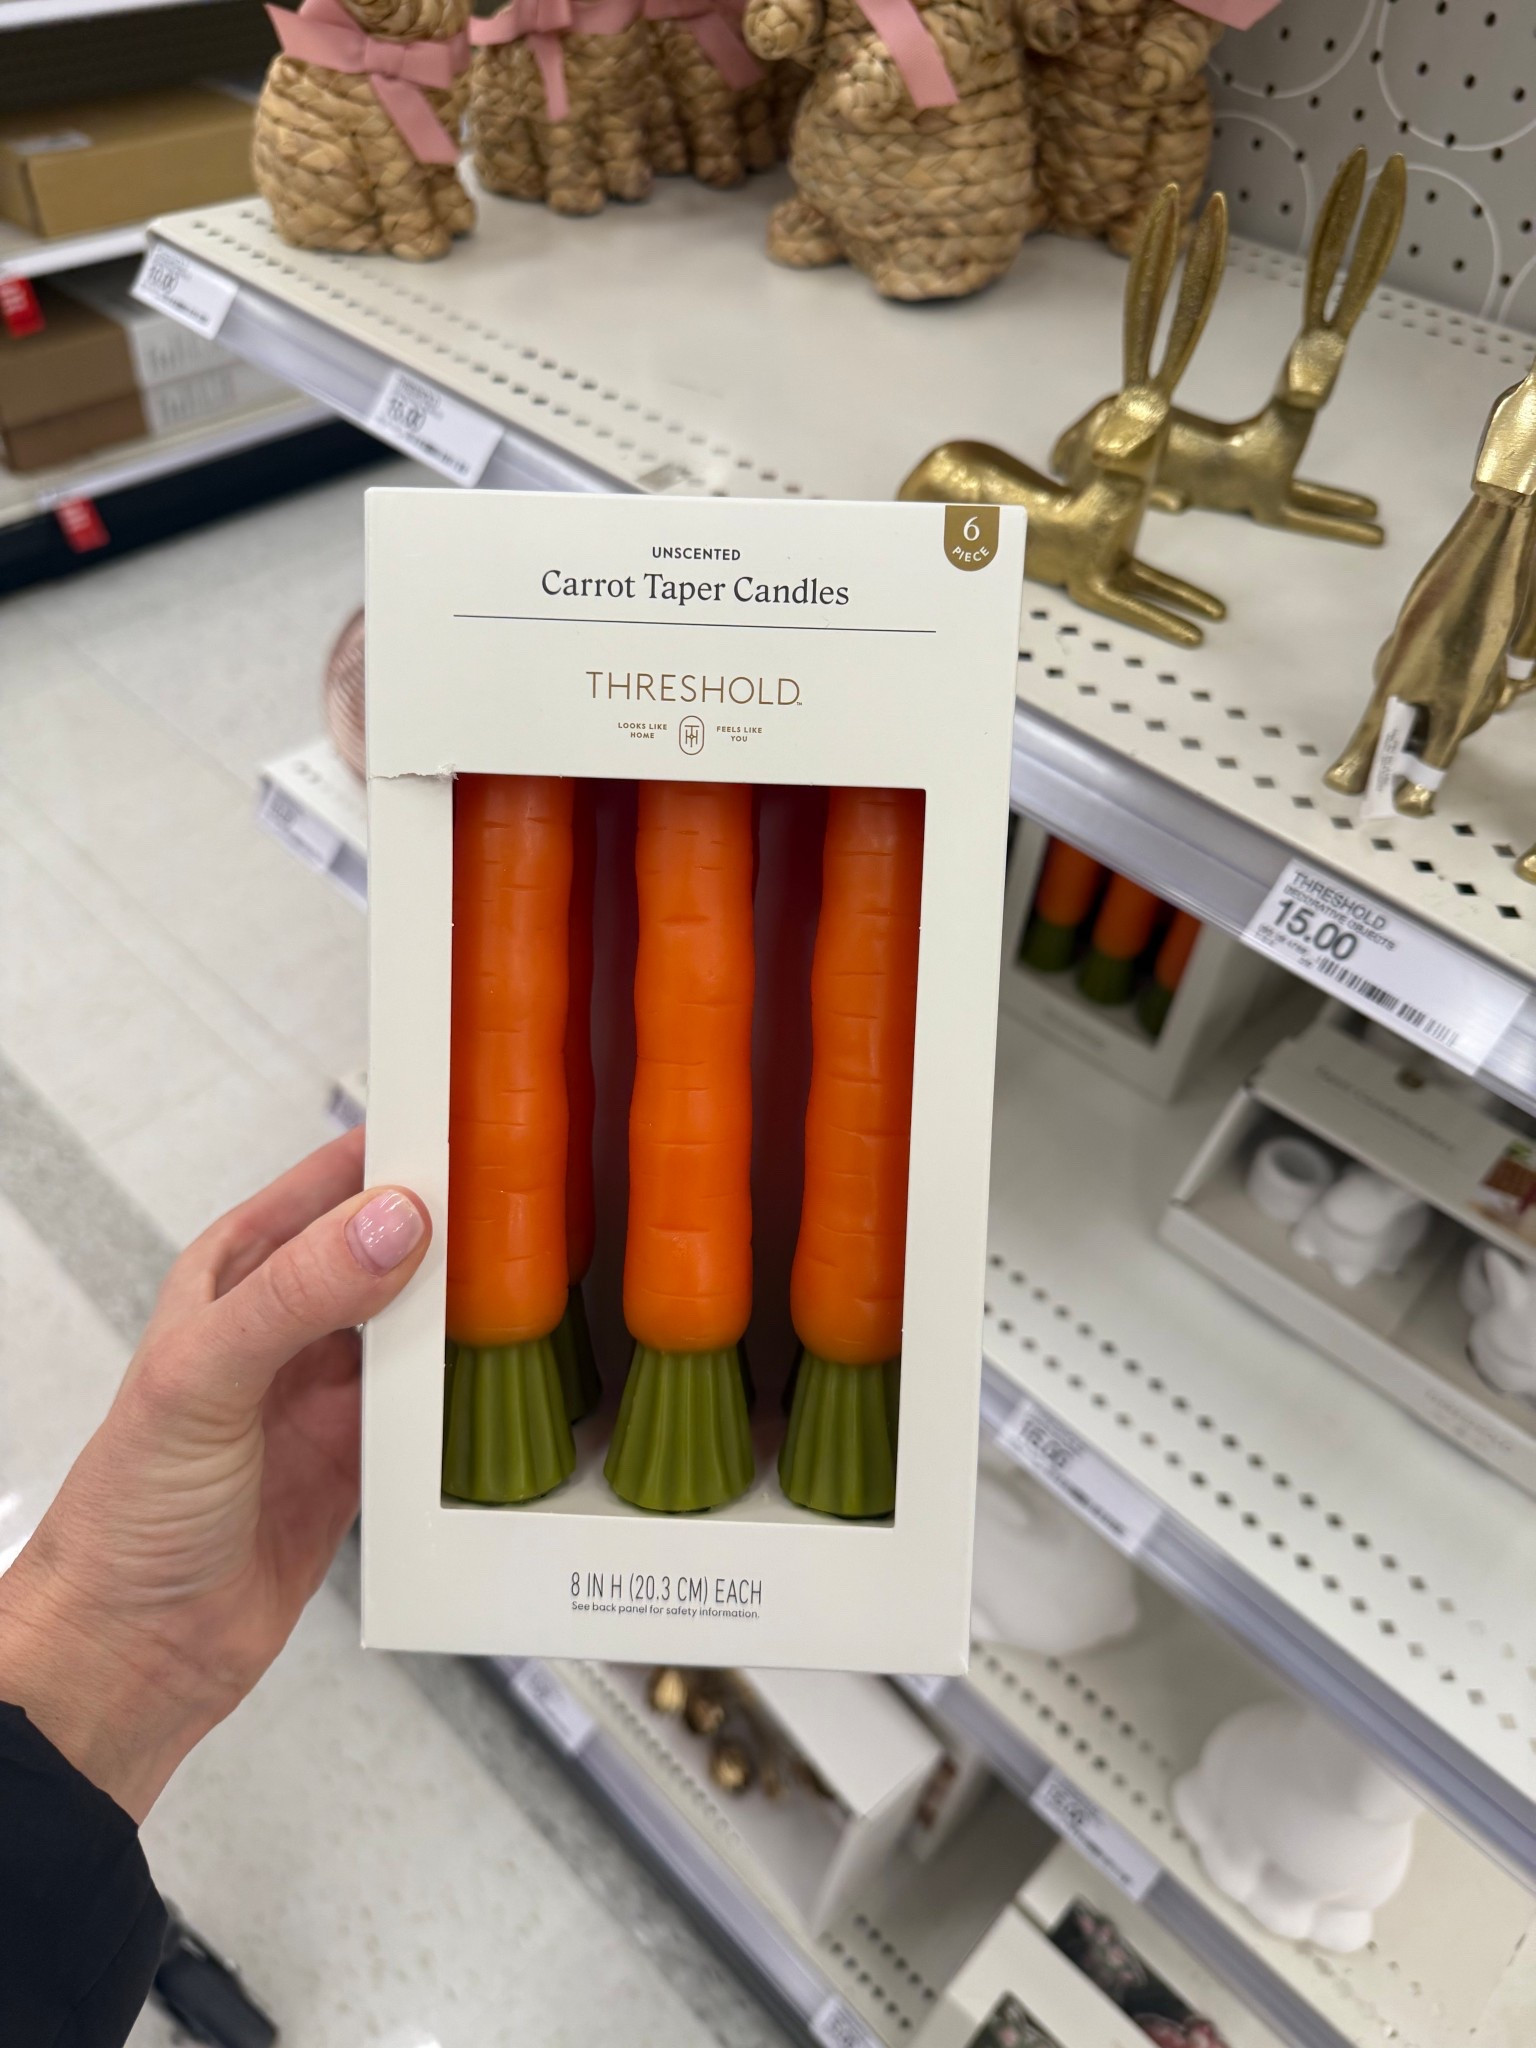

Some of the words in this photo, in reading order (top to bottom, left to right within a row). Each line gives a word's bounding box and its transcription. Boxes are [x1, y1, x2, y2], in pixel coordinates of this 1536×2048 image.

[963, 516, 980, 541] 6
[652, 546, 741, 561] UNSCENTED
[952, 546, 990, 562] PIECE
[541, 569, 636, 598] Carrot
[643, 573, 726, 606] Taper
[733, 576, 849, 605] Candles
[618, 722, 646, 730] LOOKS
[649, 723, 668, 731] LIKE
[1292, 872, 1386, 931] THRESHOLD
[1274, 899, 1358, 960] 15.00
[1283, 884, 1347, 927] DECORATIVE
[1346, 918, 1396, 951] OBJECTS
[571, 1571, 580, 1597] 8
[587, 1572, 604, 1598] IN
[611, 1573, 622, 1598] H
[629, 1573, 670, 1601] (20.3
[677, 1576, 708, 1605] CM)
[715, 1578, 762, 1605] EACH
[572, 1601, 590, 1611] See
[592, 1602, 616, 1612] back
[618, 1605, 648, 1614] panel
[650, 1605, 665, 1614] for
[666, 1605, 698, 1617] safety
[699, 1608, 760, 1619] information.
